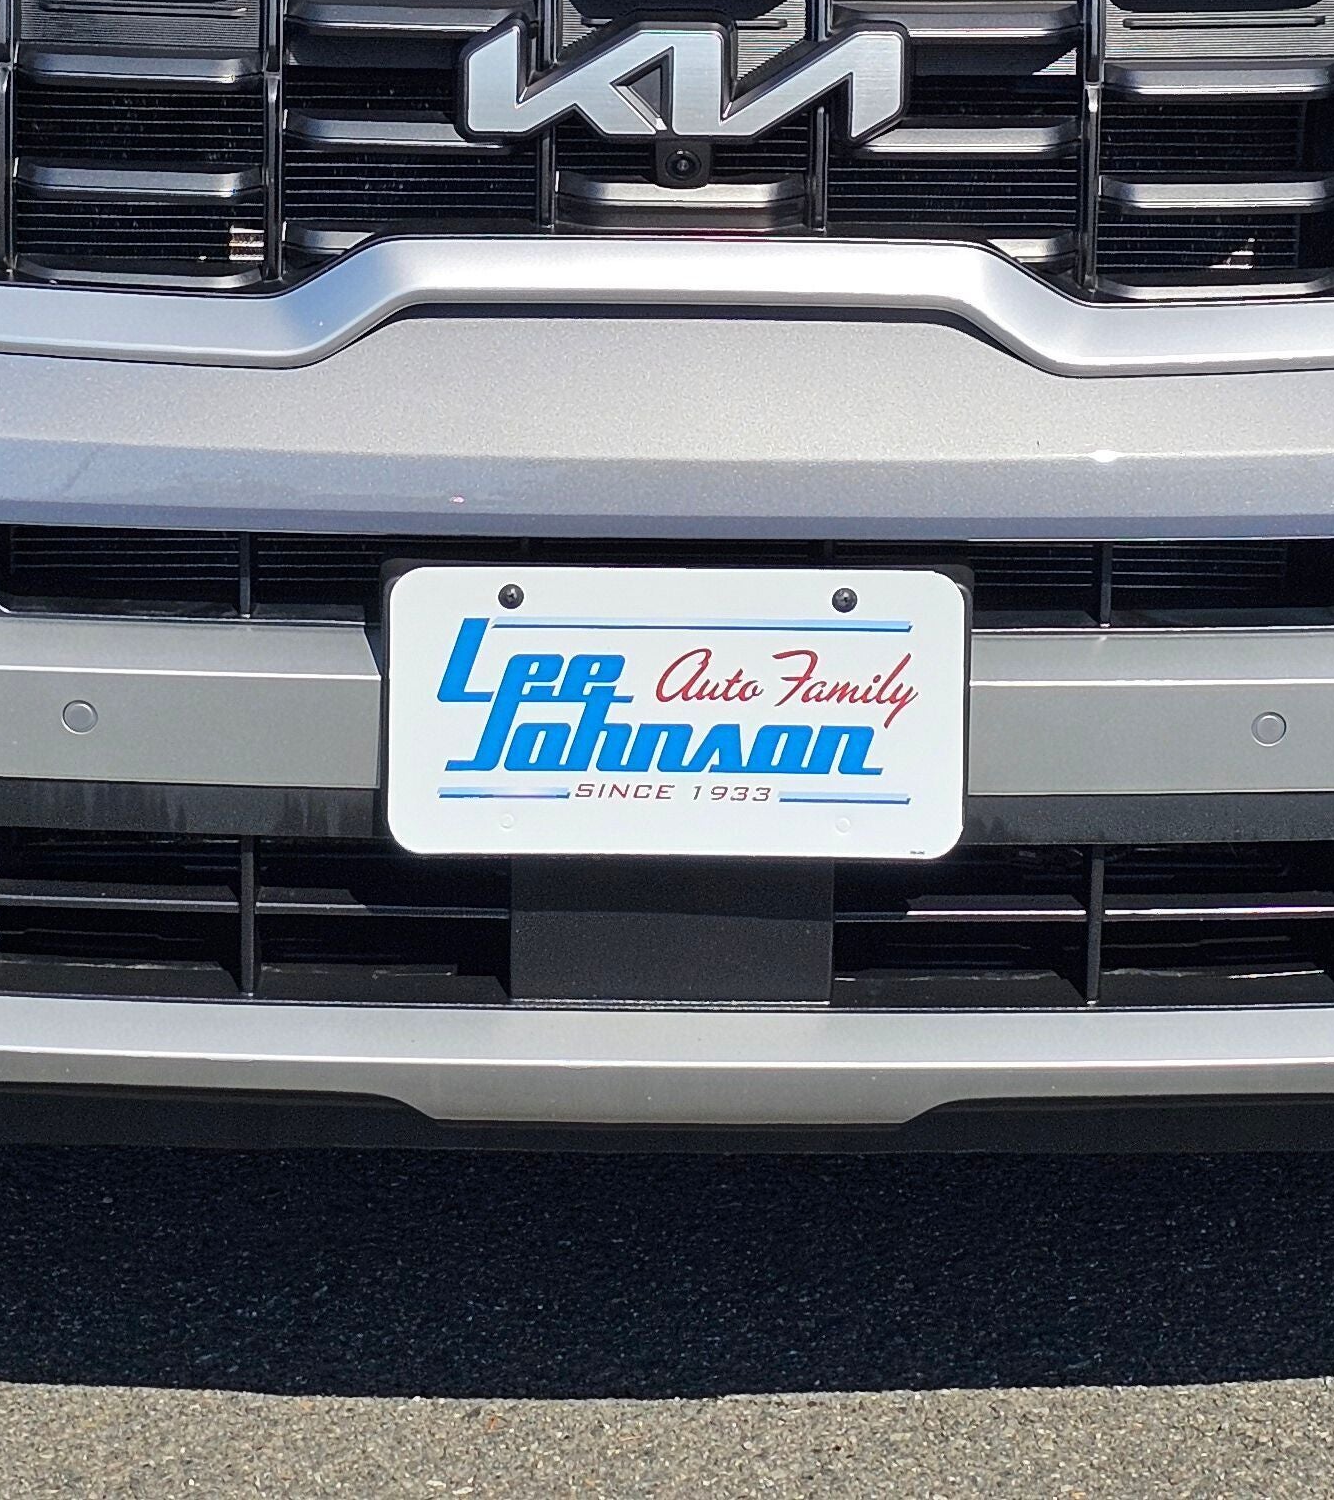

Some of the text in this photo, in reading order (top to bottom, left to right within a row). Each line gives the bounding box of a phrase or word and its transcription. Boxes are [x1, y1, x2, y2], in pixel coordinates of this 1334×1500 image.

[466, 25, 905, 140] KIA
[436, 617, 919, 728] Lee Auto Family
[444, 699, 884, 776] Johnson
[573, 782, 773, 803] SINCE 1933
